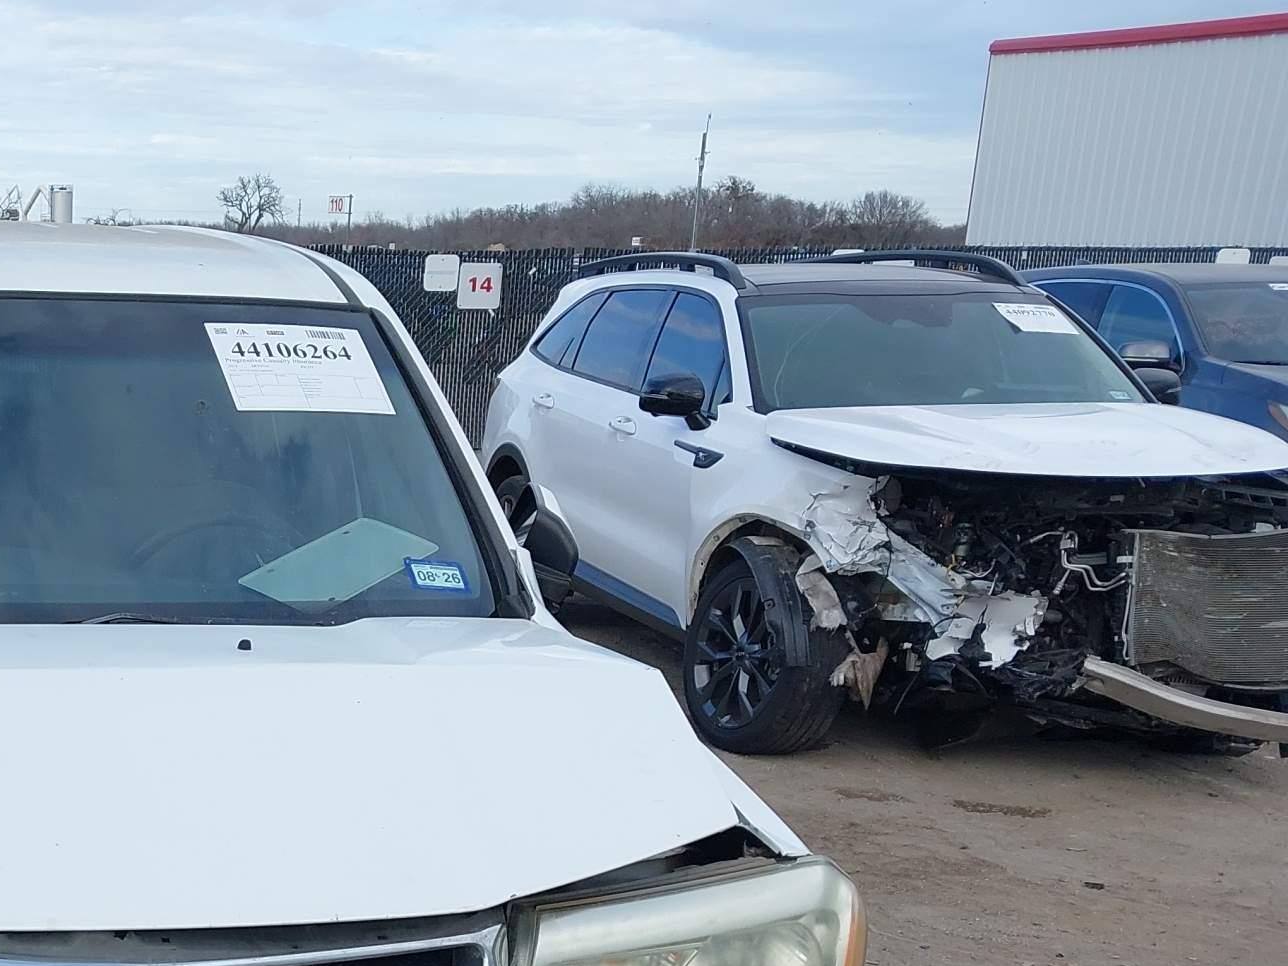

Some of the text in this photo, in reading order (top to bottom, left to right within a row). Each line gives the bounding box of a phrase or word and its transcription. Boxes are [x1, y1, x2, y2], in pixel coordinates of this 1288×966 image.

[469, 277, 493, 292] 14
[231, 341, 352, 361] 44106264
[416, 570, 461, 584] 08 26
